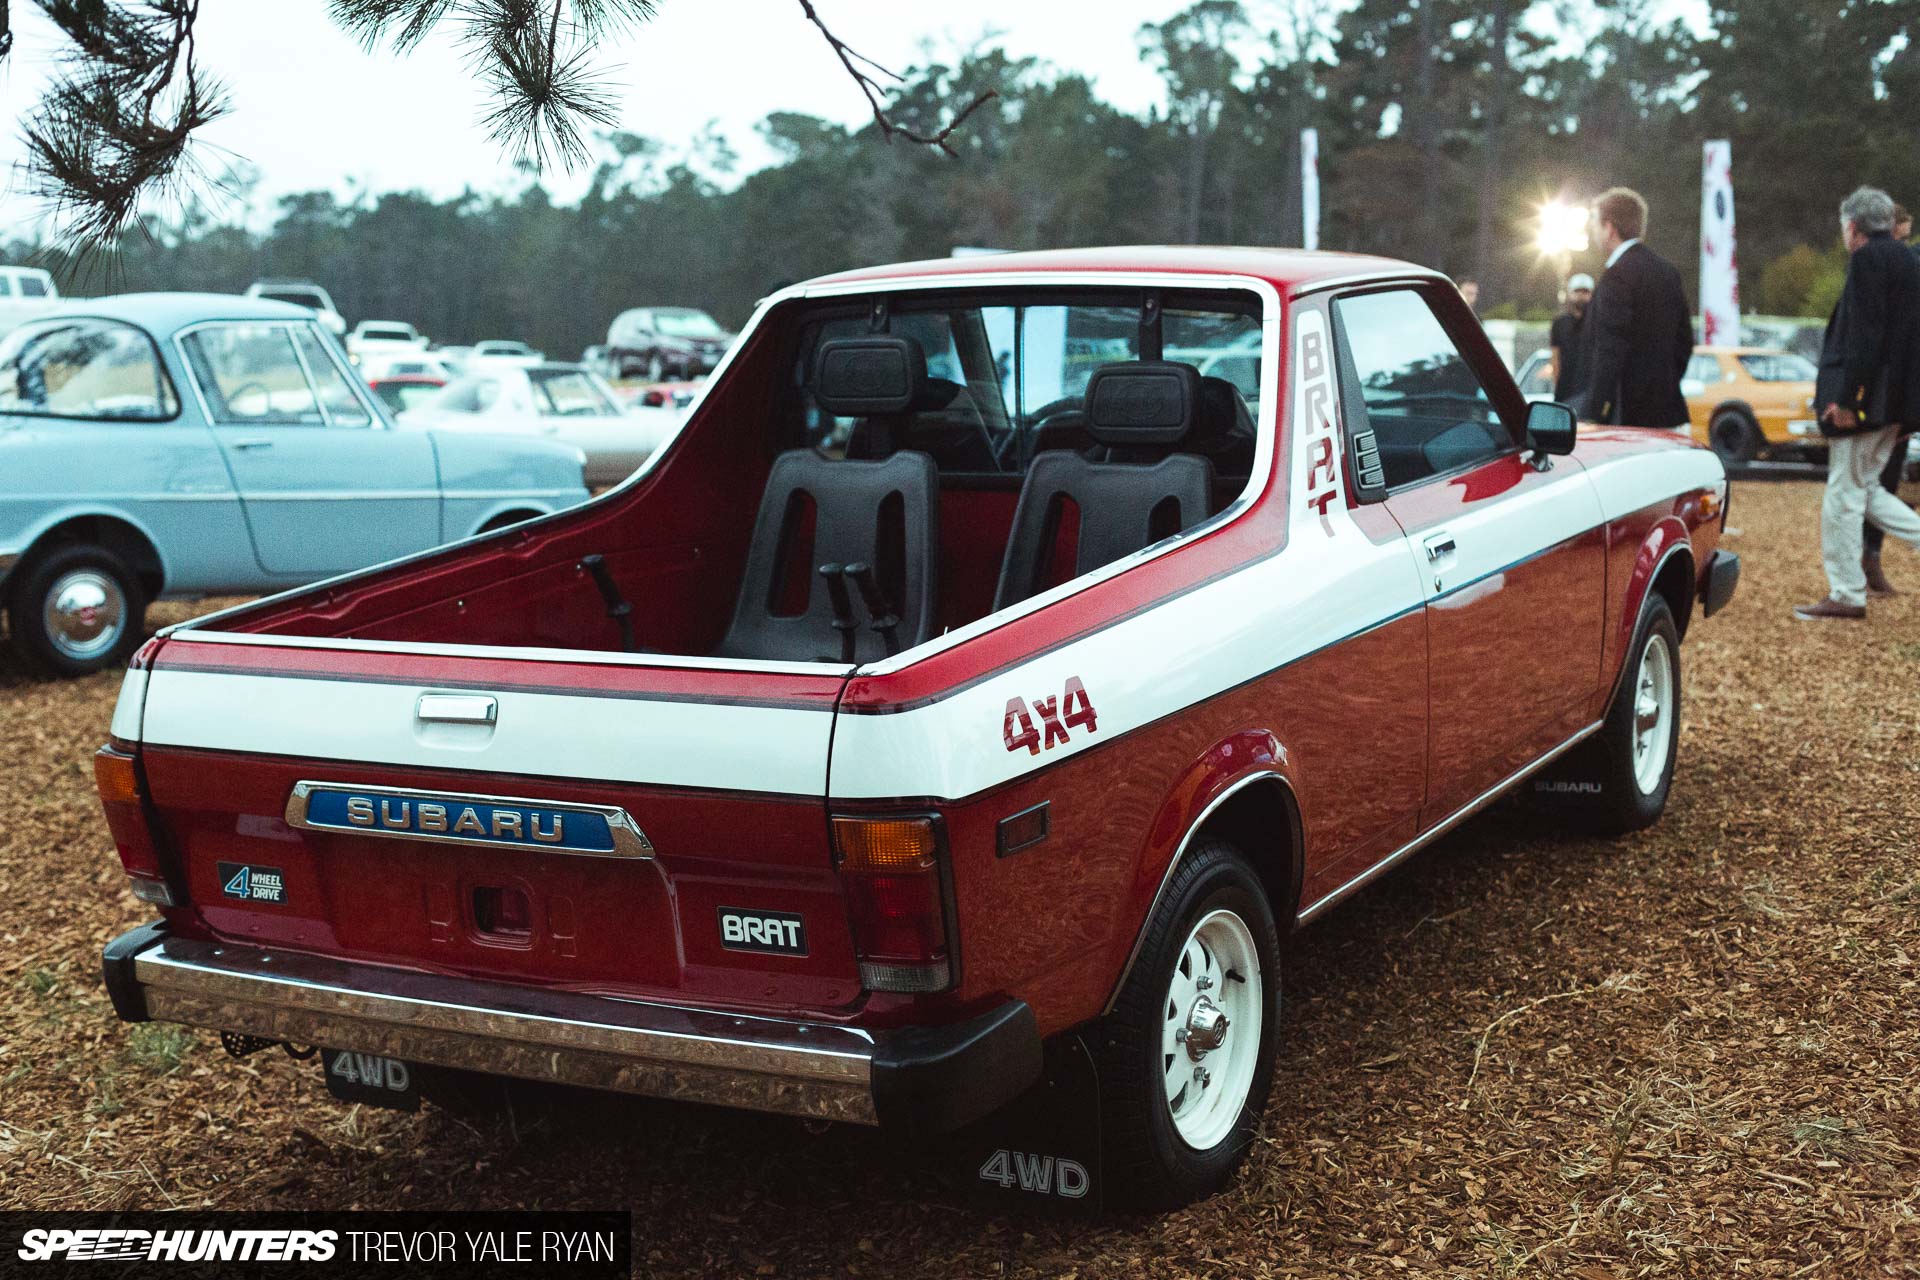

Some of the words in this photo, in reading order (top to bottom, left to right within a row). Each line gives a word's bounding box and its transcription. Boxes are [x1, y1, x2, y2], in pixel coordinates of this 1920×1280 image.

[1302, 331, 1337, 538] BRAT
[1535, 781, 1602, 793] SUBARU
[347, 796, 564, 843] SUBARU
[224, 866, 251, 899] 4
[251, 873, 282, 886] WHEEL
[252, 887, 281, 901] DRIVE
[722, 914, 801, 948] BRAT
[331, 1051, 410, 1092] 4WD
[979, 1149, 1090, 1198] 4WD
